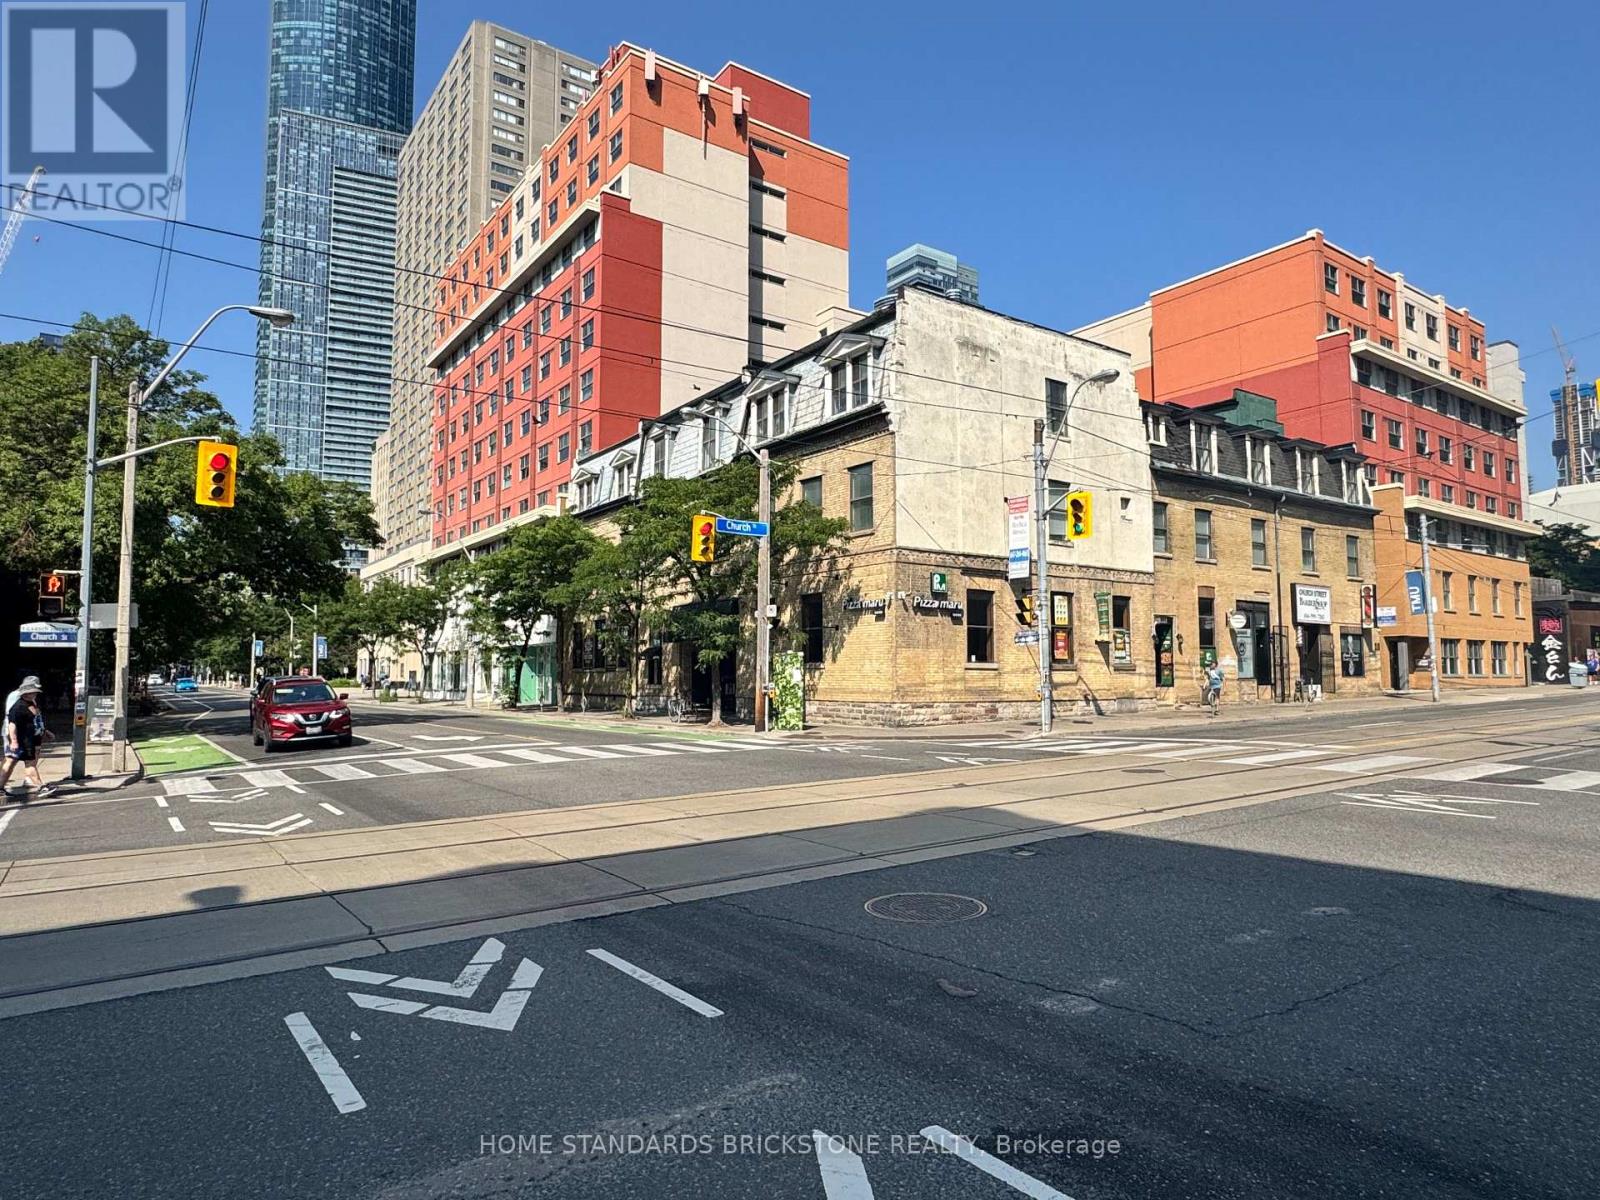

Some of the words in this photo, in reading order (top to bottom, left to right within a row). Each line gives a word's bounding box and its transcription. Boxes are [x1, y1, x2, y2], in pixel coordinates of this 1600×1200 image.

[726, 520, 751, 532] Church
[843, 600, 861, 609] Pizza
[862, 599, 883, 609] maru
[914, 596, 939, 608] Pizza
[940, 600, 962, 609] maru
[1408, 586, 1421, 613] TMU
[31, 632, 58, 641] Church
